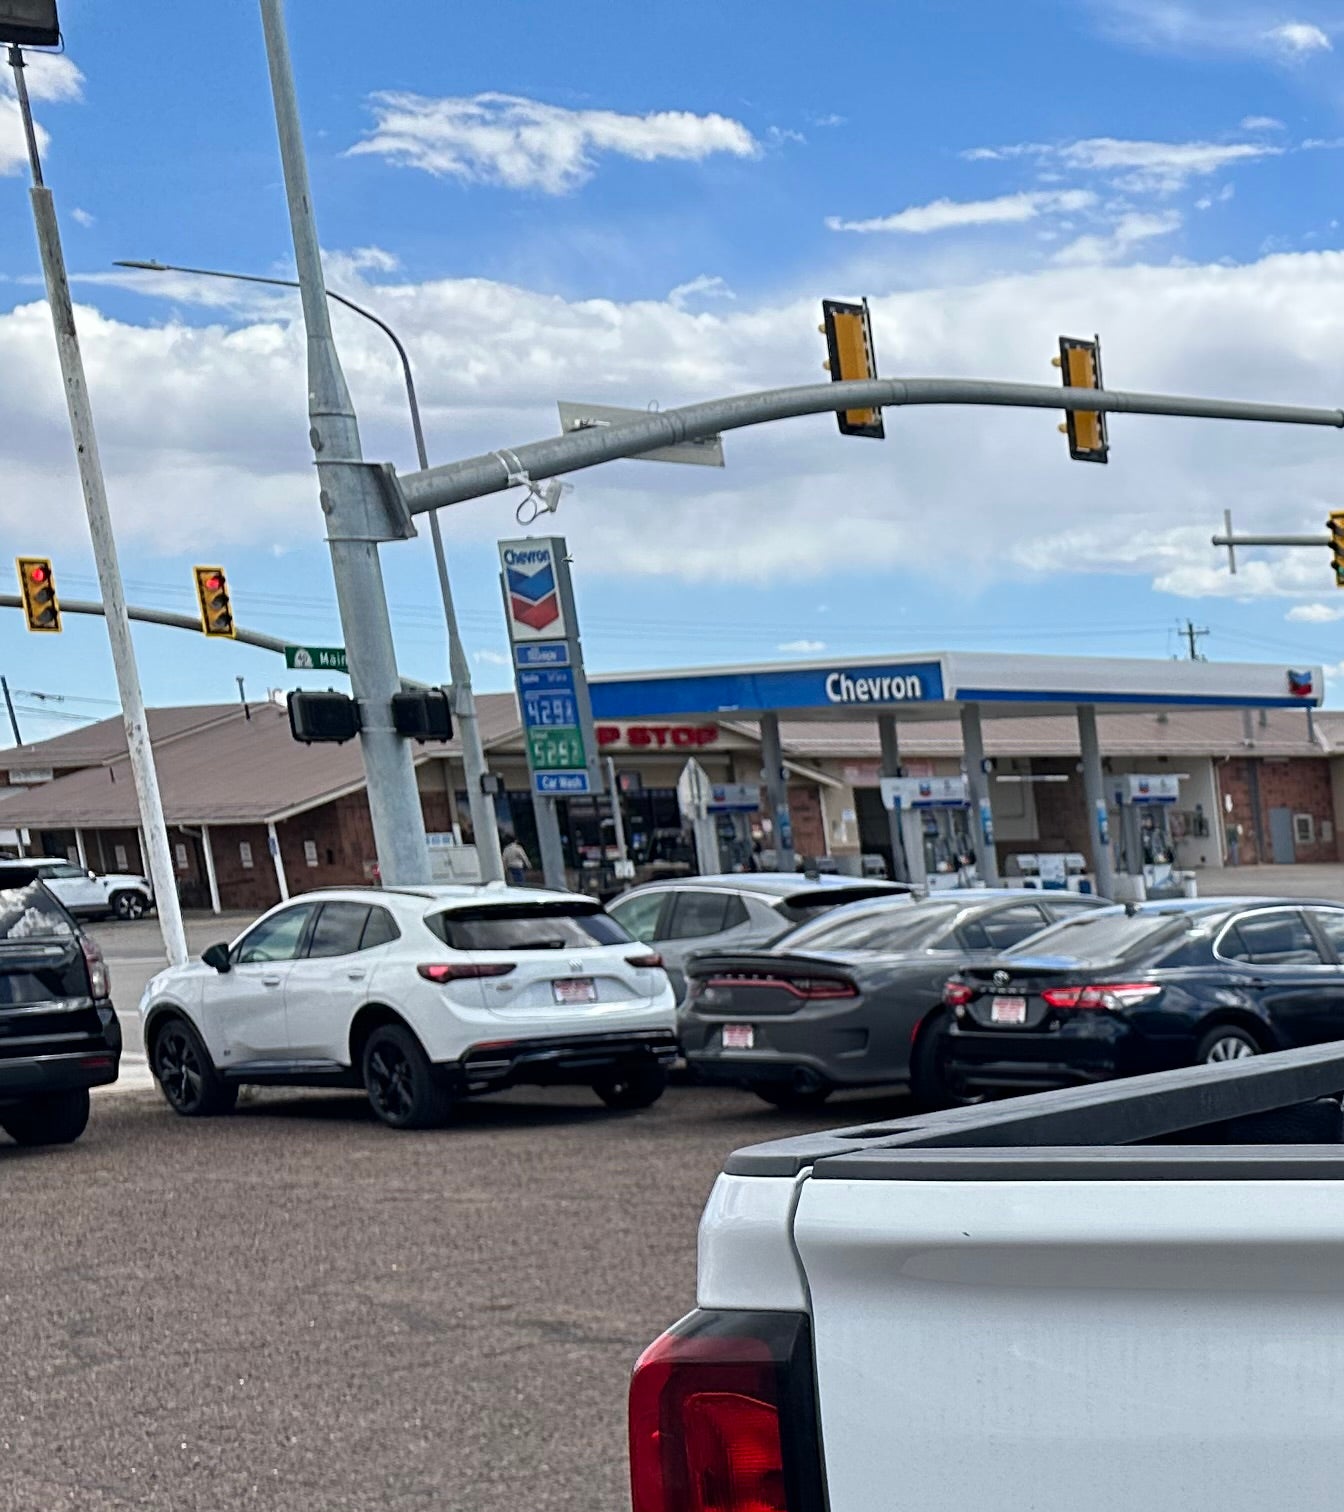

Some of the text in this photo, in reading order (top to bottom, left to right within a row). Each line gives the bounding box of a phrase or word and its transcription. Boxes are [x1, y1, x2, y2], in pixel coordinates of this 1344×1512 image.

[504, 549, 551, 565] Chevron
[826, 672, 922, 702] Chevron
[626, 725, 719, 746] STOP
